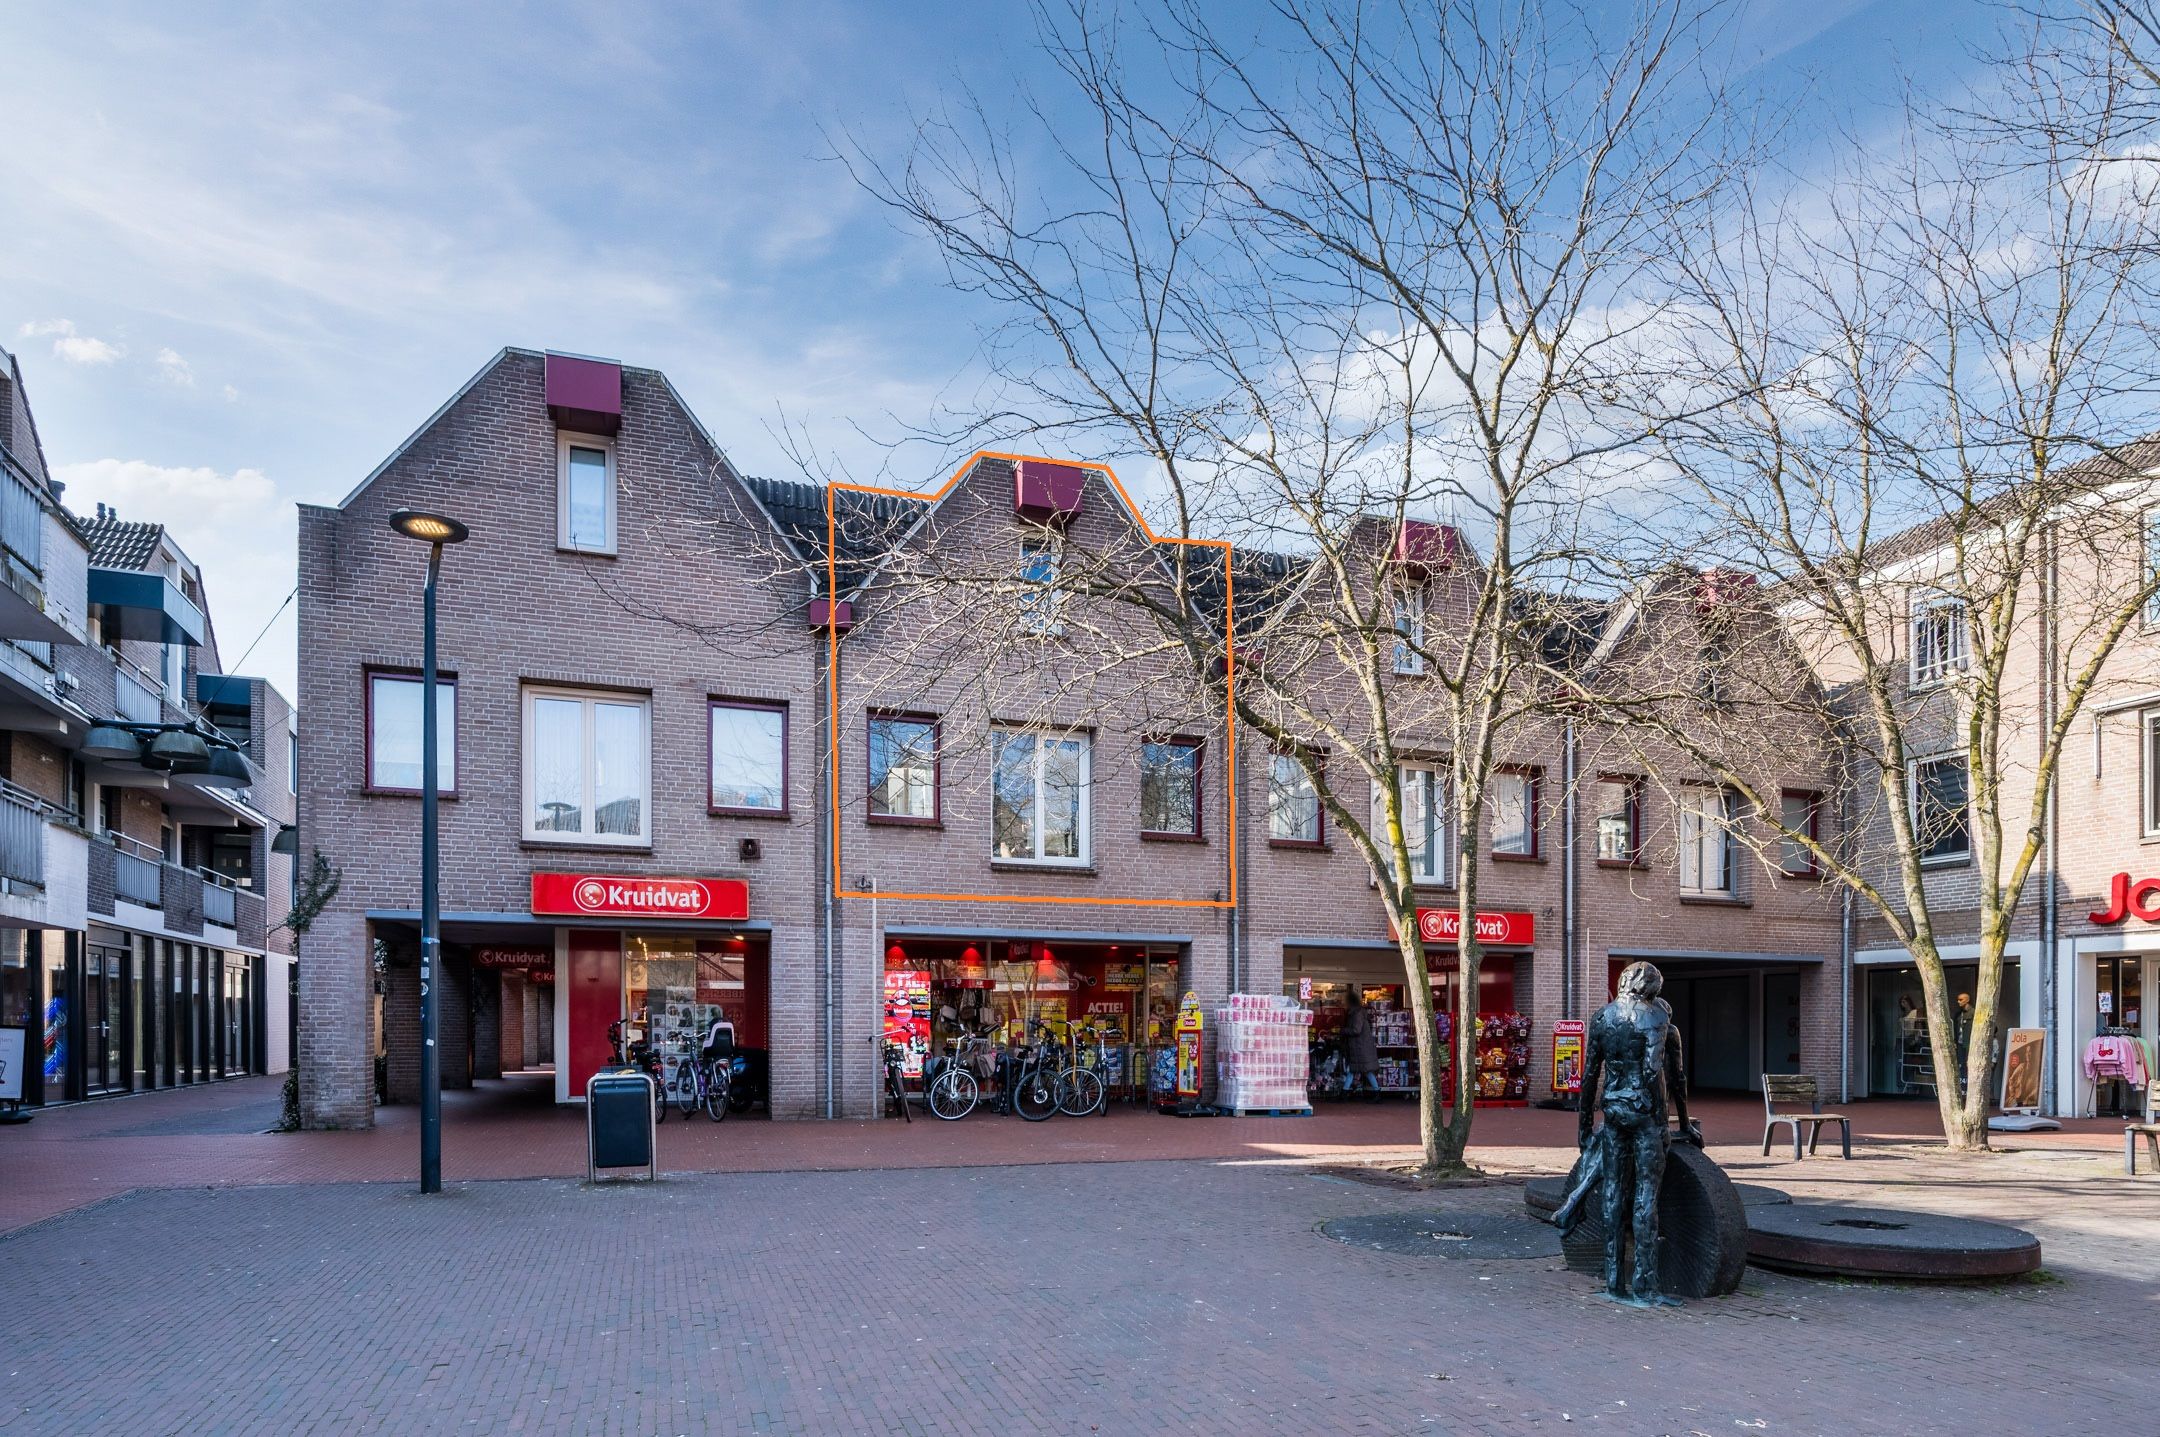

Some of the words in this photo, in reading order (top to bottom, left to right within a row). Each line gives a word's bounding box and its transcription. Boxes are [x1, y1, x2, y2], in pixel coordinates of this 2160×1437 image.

[608, 885, 701, 908] Kruidvat
[1443, 918, 1503, 935] Krdvat
[495, 951, 545, 963] Kruidvat
[1088, 1002, 1124, 1013] ACTIE!
[1561, 1023, 1582, 1032] Kruidvat
[2011, 1033, 2027, 1042] Jola
